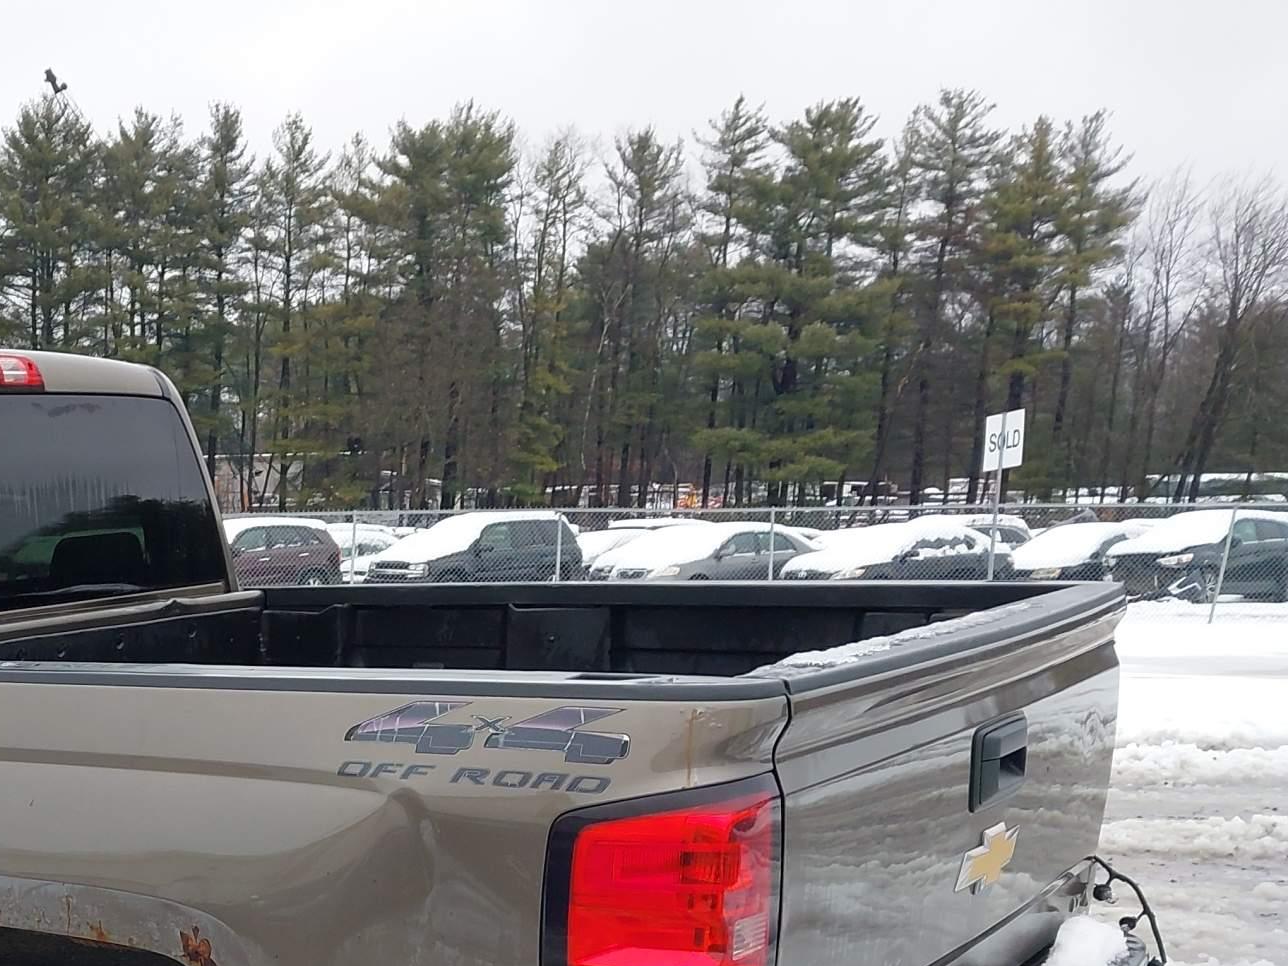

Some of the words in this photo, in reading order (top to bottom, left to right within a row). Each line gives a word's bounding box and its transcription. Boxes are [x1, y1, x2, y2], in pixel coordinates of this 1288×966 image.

[989, 429, 1021, 453] SOLD
[336, 760, 436, 781] OFF
[449, 767, 612, 794] ROAD
